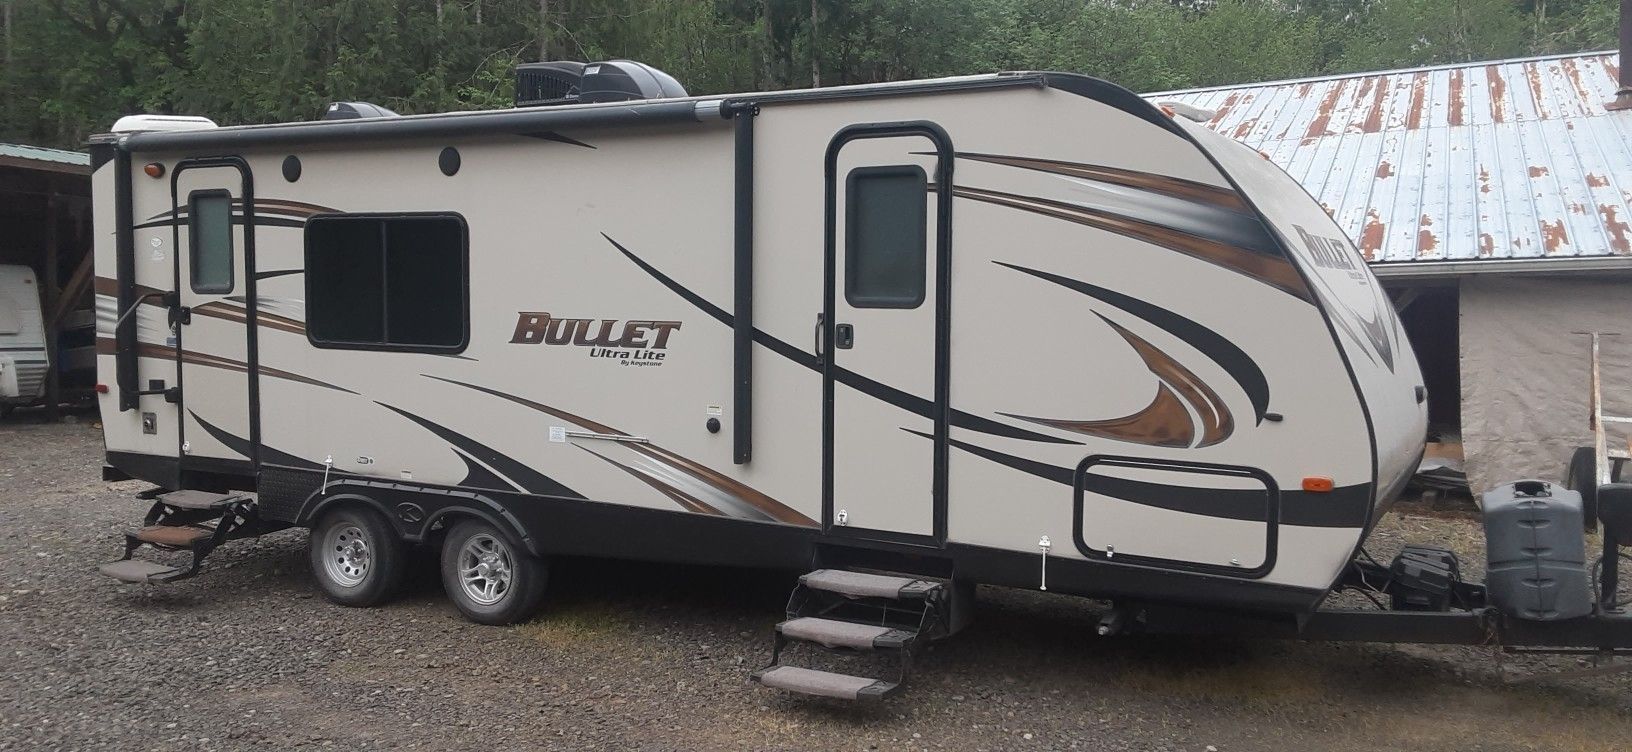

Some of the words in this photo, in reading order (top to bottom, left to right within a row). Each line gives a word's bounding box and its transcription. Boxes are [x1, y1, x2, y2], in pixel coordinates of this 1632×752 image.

[1291, 223, 1357, 270] BULLET
[508, 311, 682, 350] BULLET
[590, 347, 630, 360] Ultra
[634, 349, 666, 361] Lite
[620, 359, 629, 367] By
